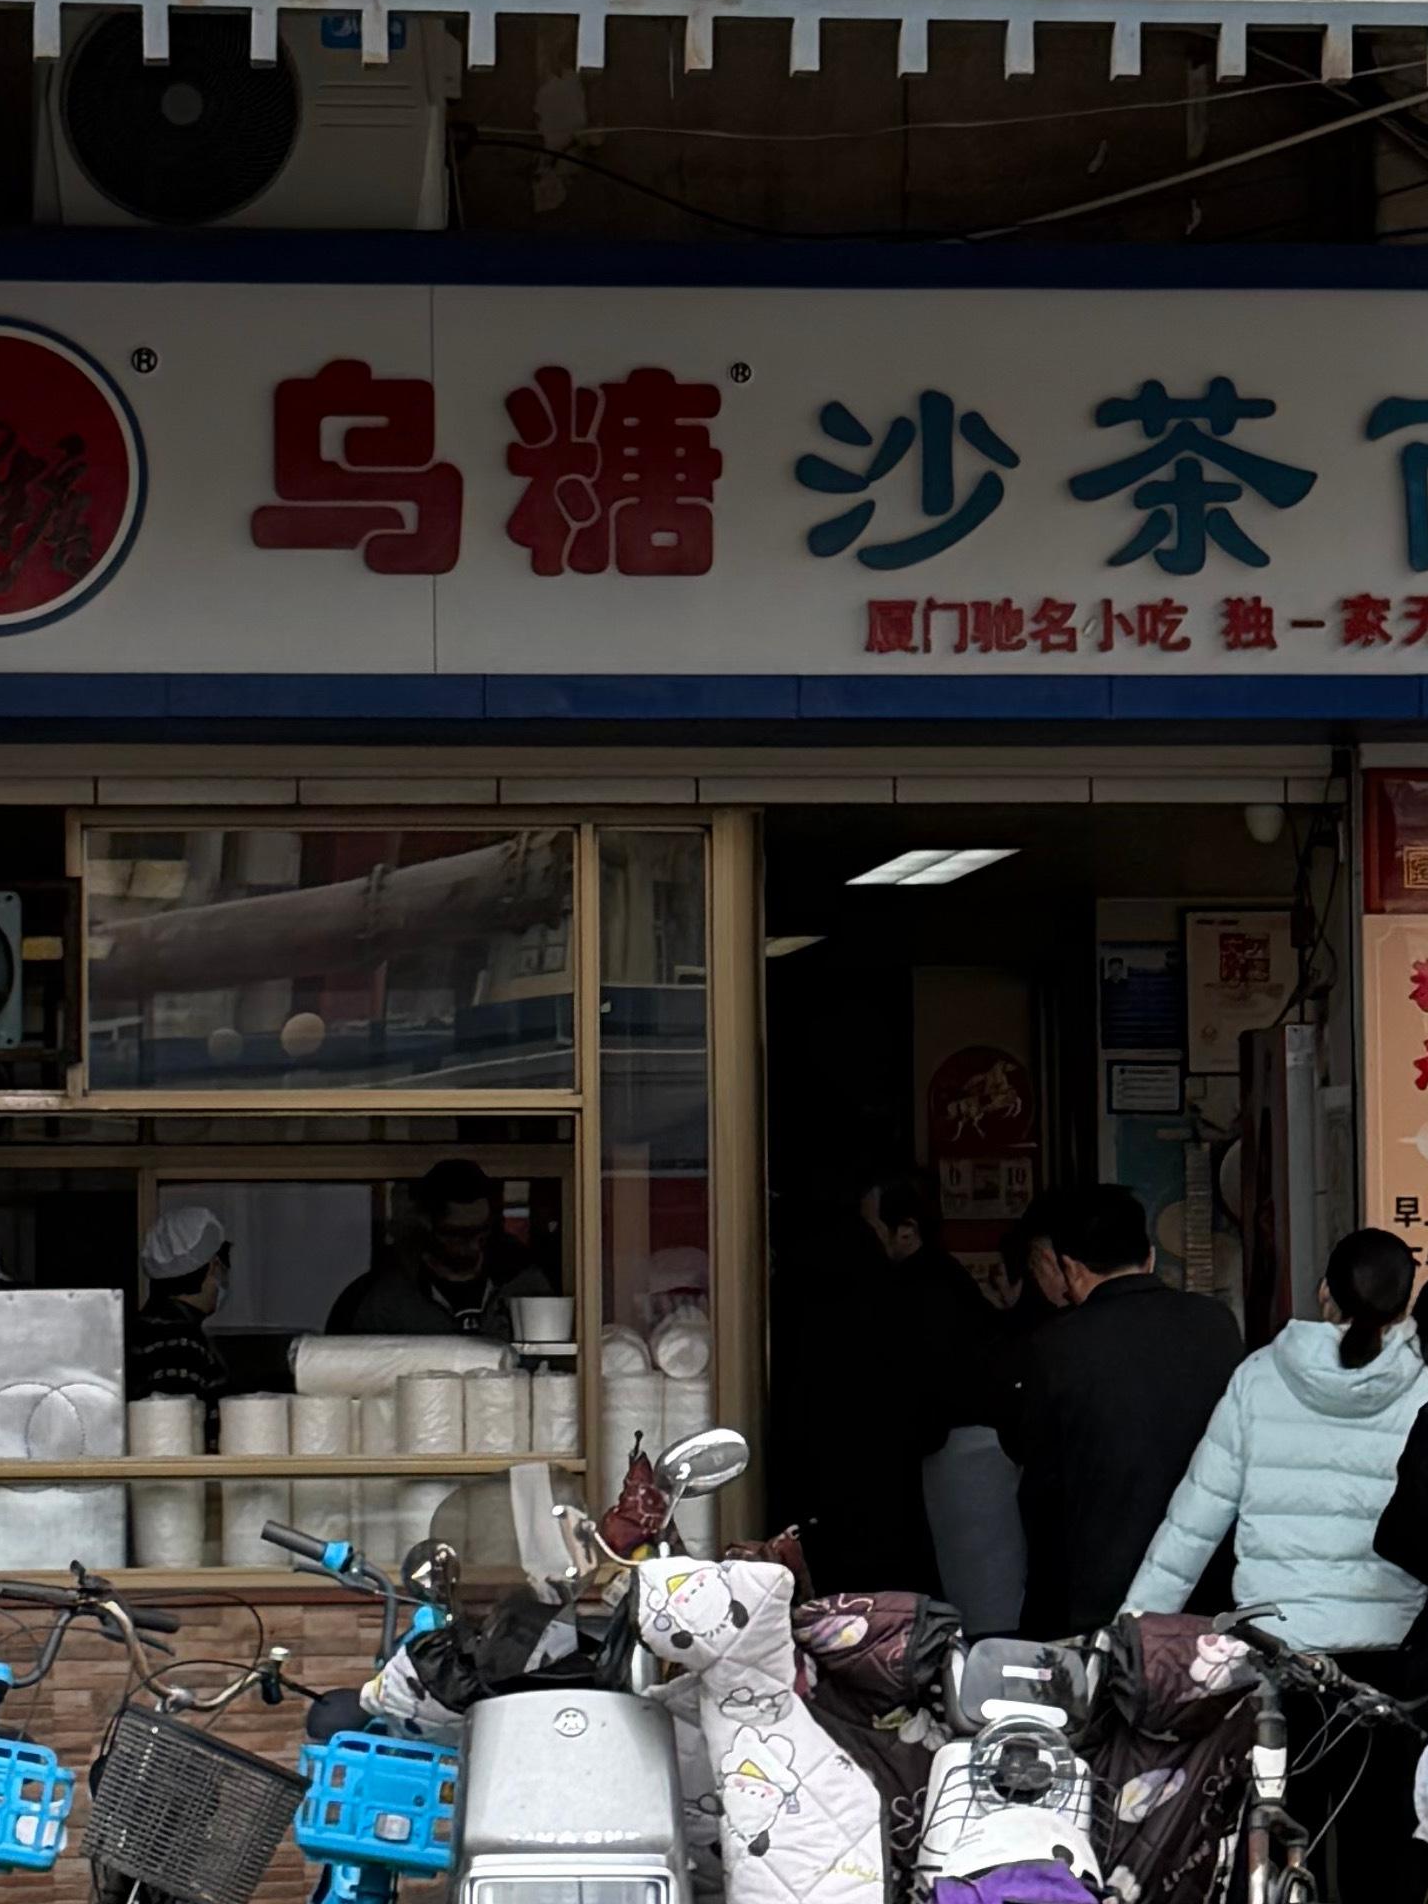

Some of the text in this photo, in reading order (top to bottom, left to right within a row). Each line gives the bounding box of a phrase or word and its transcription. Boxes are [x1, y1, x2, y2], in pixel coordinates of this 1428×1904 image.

[250, 358, 723, 577] 乌糖
[865, 598, 1190, 656] 厦门驰名小吃
